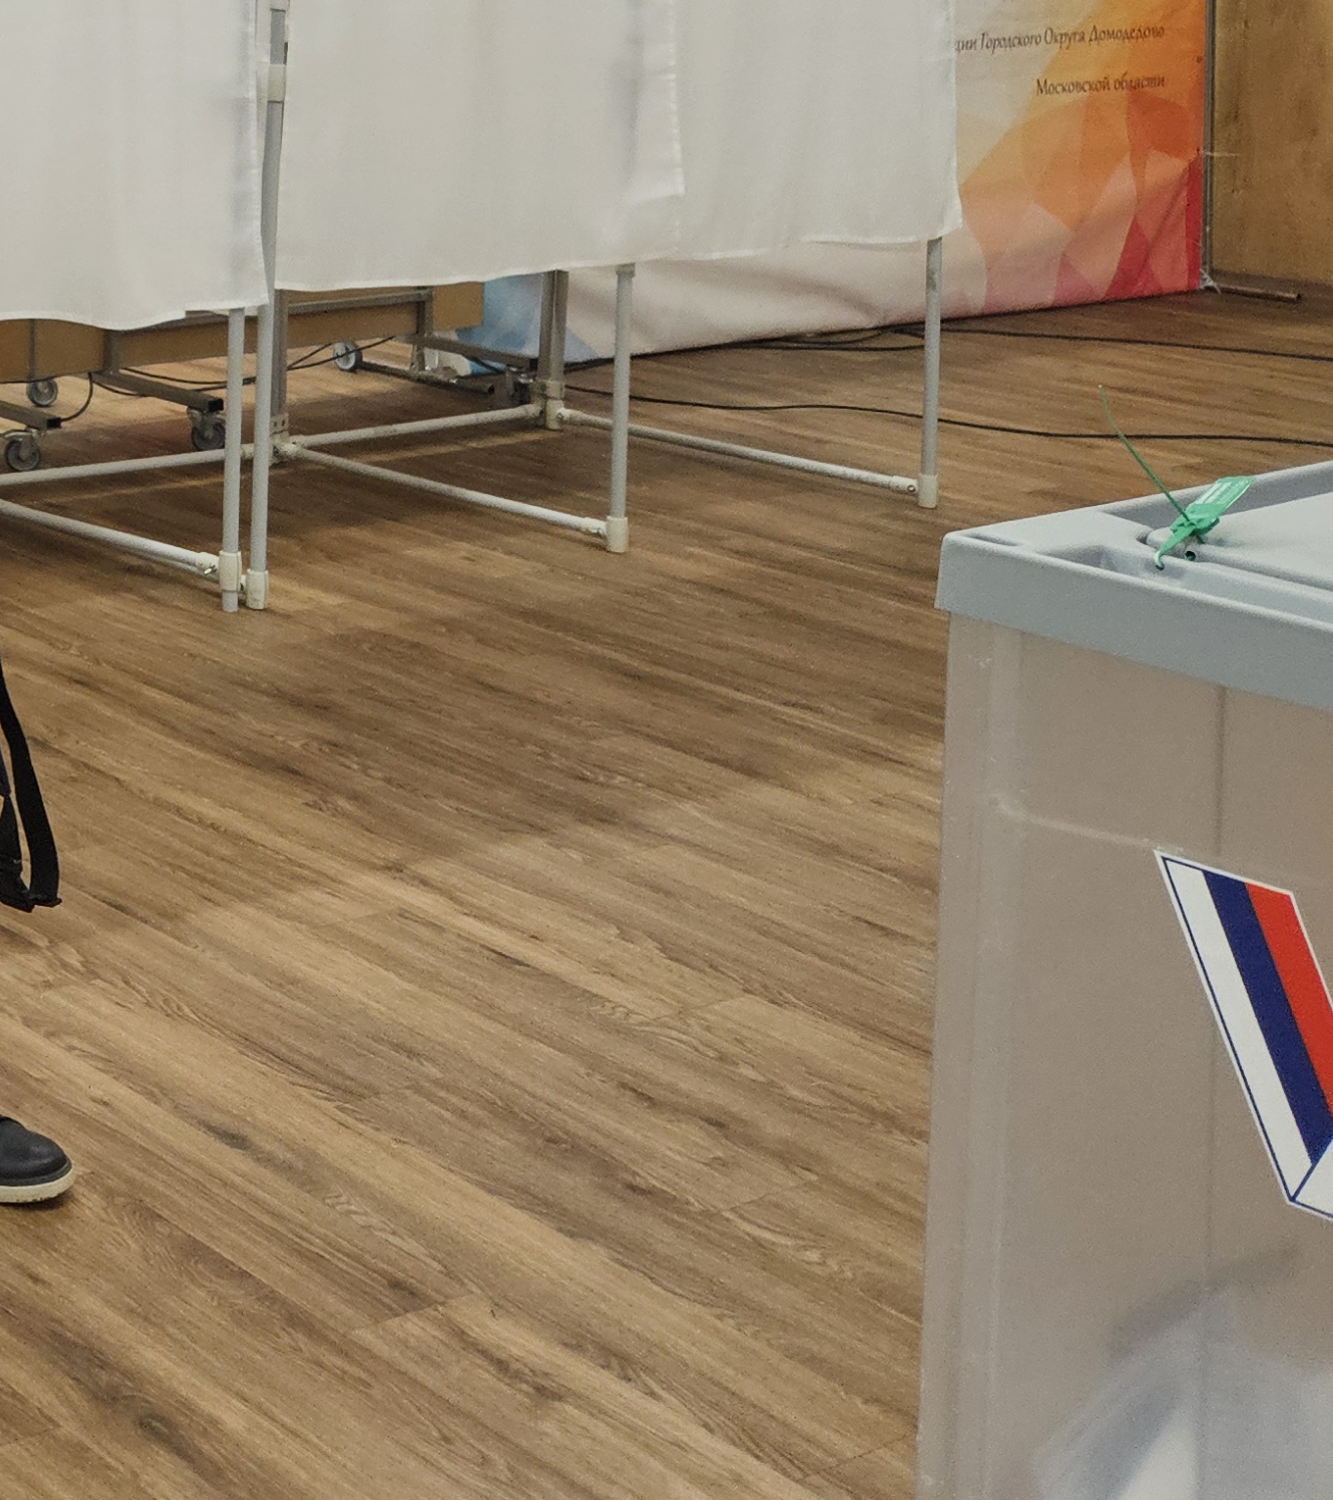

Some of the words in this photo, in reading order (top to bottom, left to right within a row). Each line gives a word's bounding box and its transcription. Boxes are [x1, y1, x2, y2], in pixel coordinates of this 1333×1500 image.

[980, 31, 1042, 56] Городского
[1044, 27, 1085, 50] Округа
[1088, 25, 1165, 44] Домодедово
[1036, 77, 1110, 97] Московской
